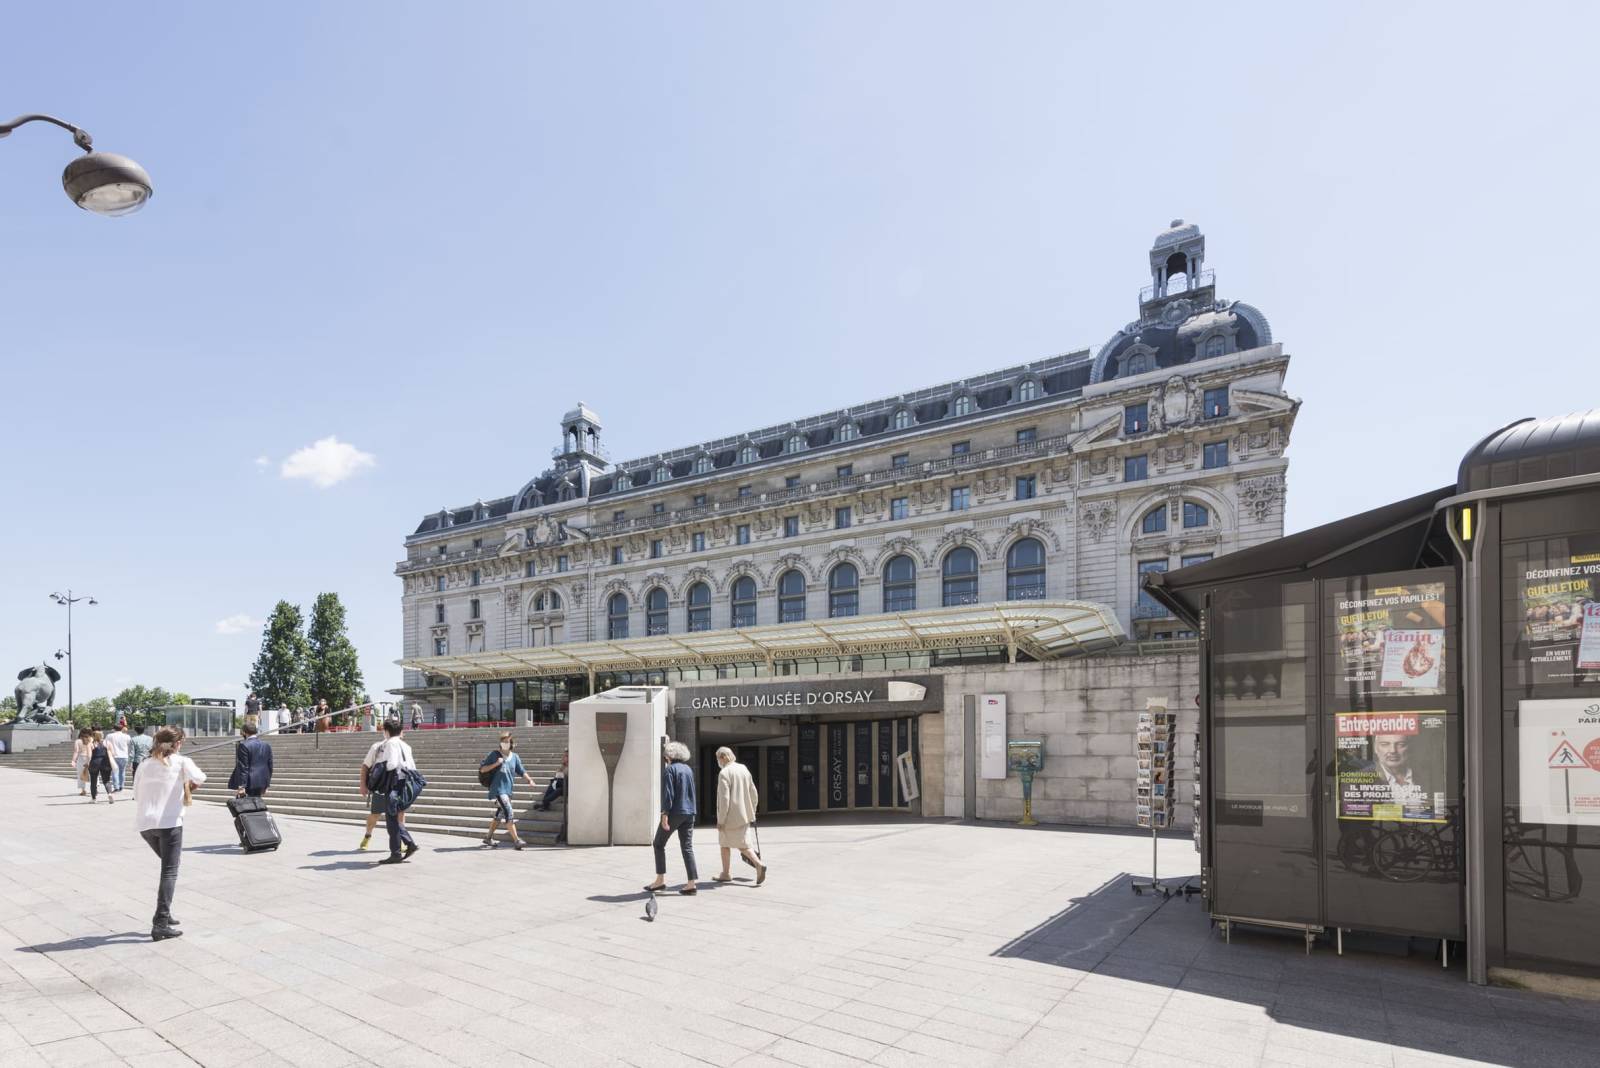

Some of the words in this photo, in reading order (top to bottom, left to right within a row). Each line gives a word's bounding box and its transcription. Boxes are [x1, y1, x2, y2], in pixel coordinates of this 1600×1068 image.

[1526, 566, 1581, 579] DÉCONFINEZ
[1527, 578, 1589, 597] GUEULETON
[1339, 598, 1384, 609] DÉCONFINEZ
[1384, 596, 1399, 605] VOS
[1400, 593, 1435, 603] PAPILLES
[1340, 608, 1390, 625] GUEULETON
[691, 696, 727, 710] GARE
[730, 695, 750, 709] DU
[754, 691, 802, 707] MUSÉE
[807, 690, 873, 705] D'ORSAY
[1338, 714, 1416, 736] Entreprendre
[833, 754, 842, 802] ORSAY
[1344, 791, 1361, 799] DES
